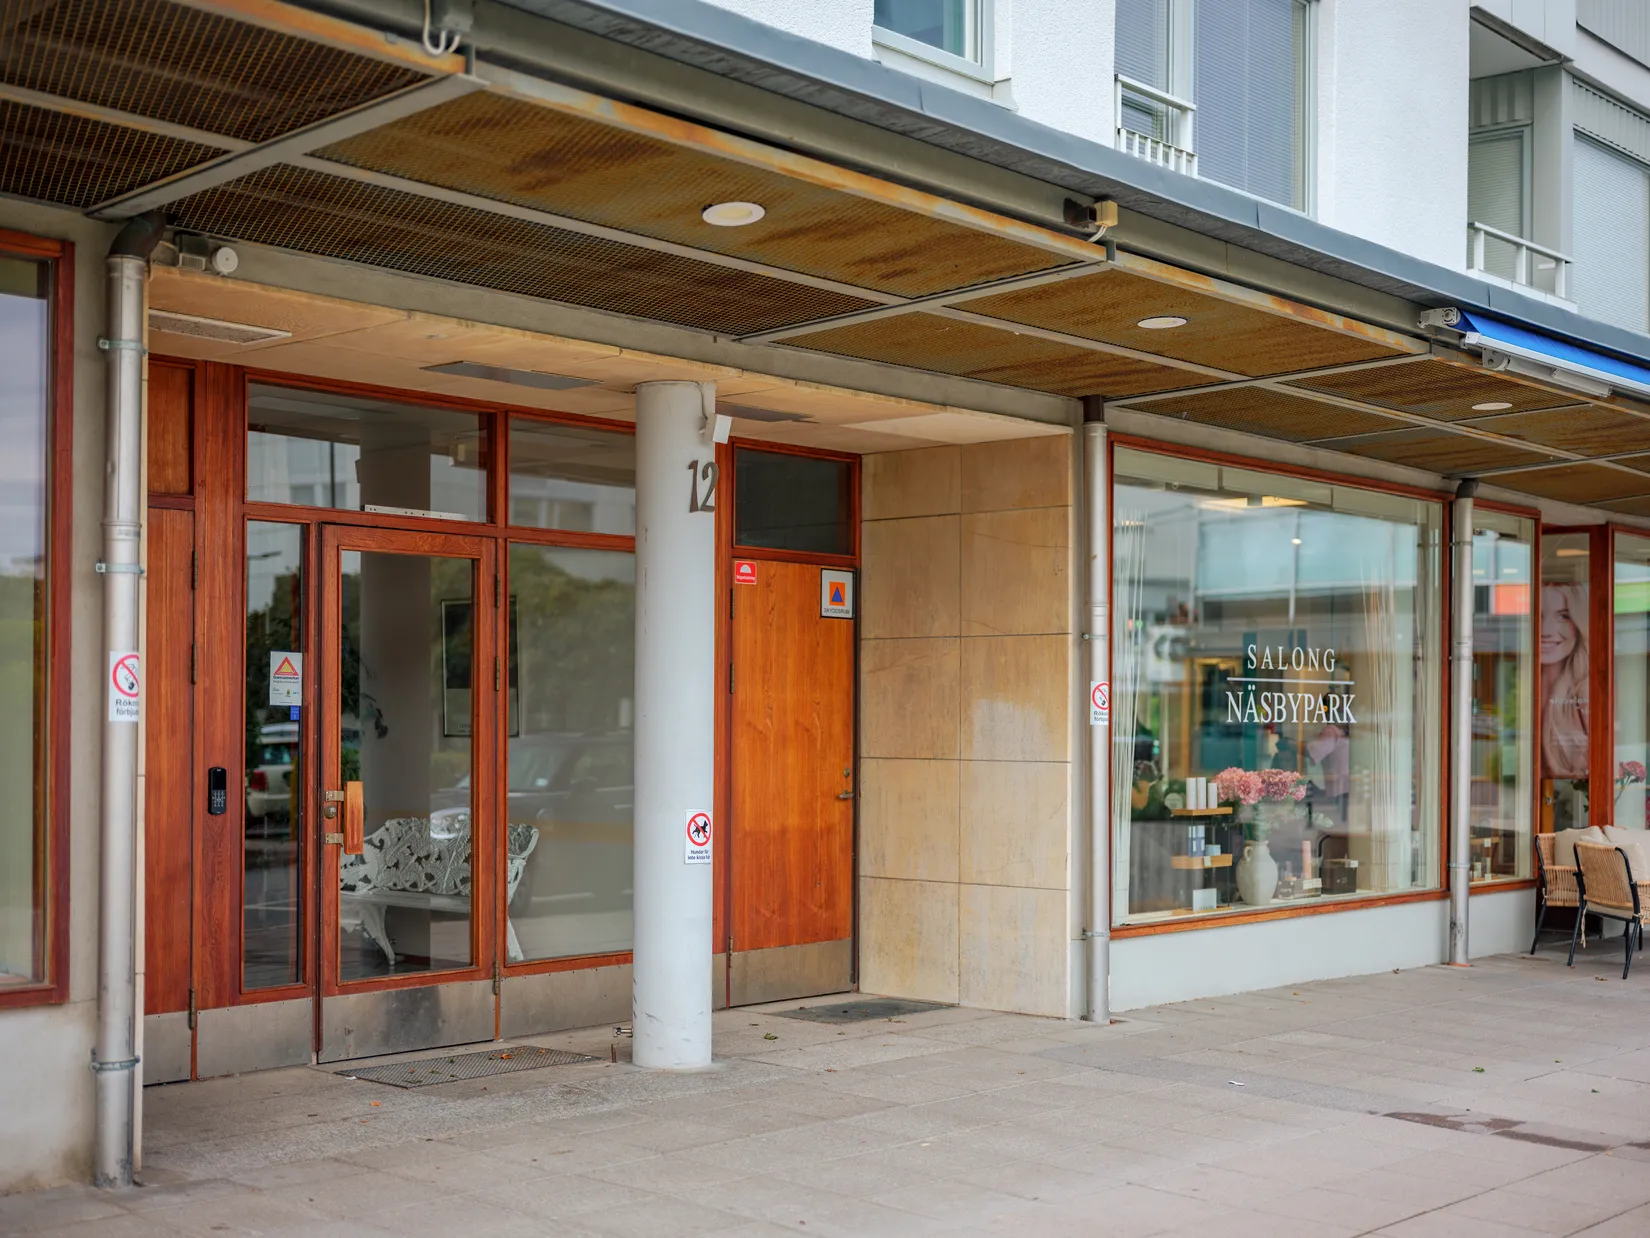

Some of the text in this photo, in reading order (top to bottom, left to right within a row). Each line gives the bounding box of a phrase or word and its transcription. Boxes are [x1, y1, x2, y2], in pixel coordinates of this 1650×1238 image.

[688, 459, 719, 513] 12
[1247, 644, 1335, 672] SALONG
[1226, 684, 1357, 724] NÄSBYPARK
